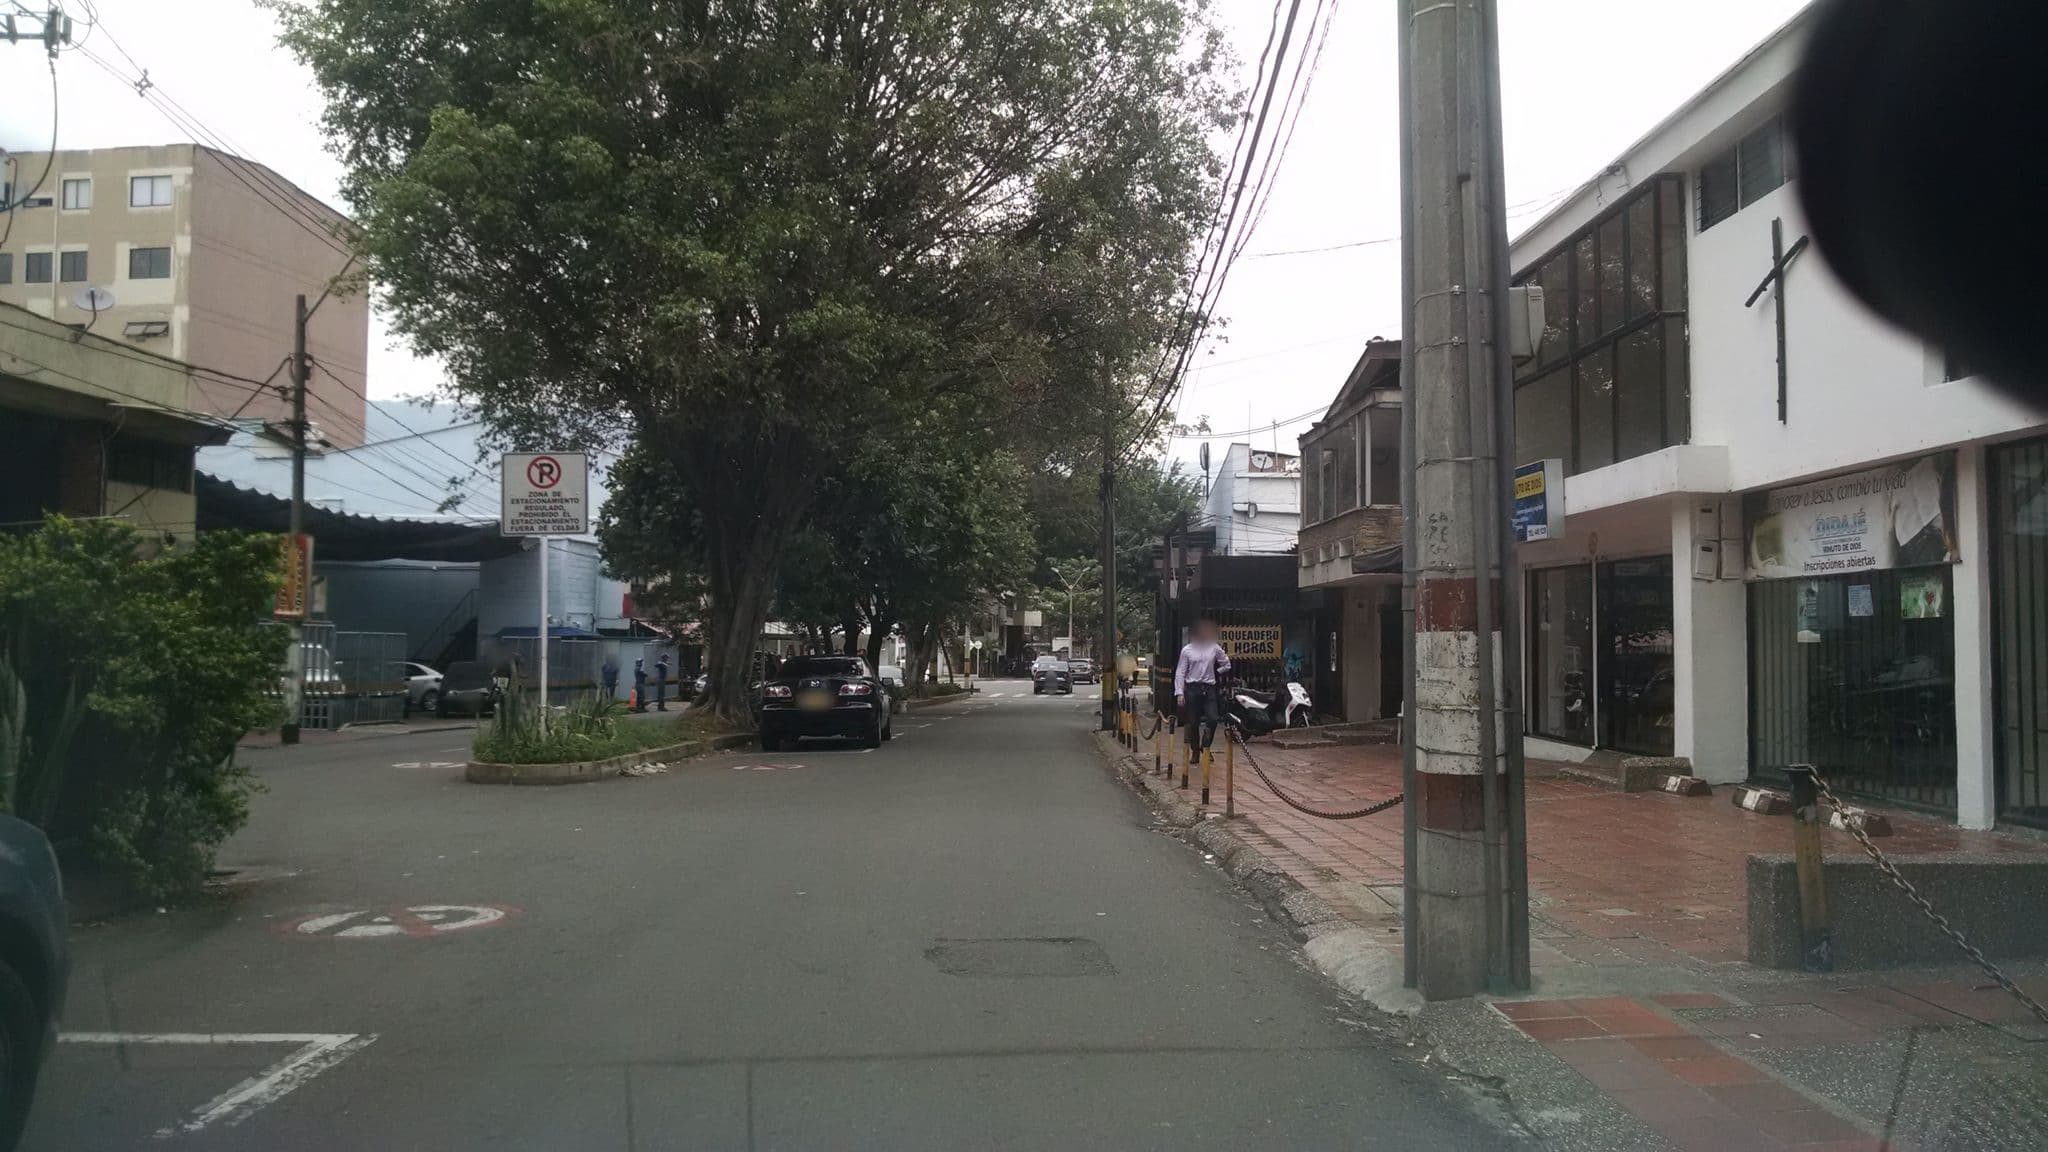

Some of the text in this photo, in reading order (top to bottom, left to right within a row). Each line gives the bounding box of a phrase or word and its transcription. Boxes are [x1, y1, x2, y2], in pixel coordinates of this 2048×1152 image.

[1804, 555, 1876, 572] Inscripciones abiertas
[1234, 642, 1274, 654] HORAS
